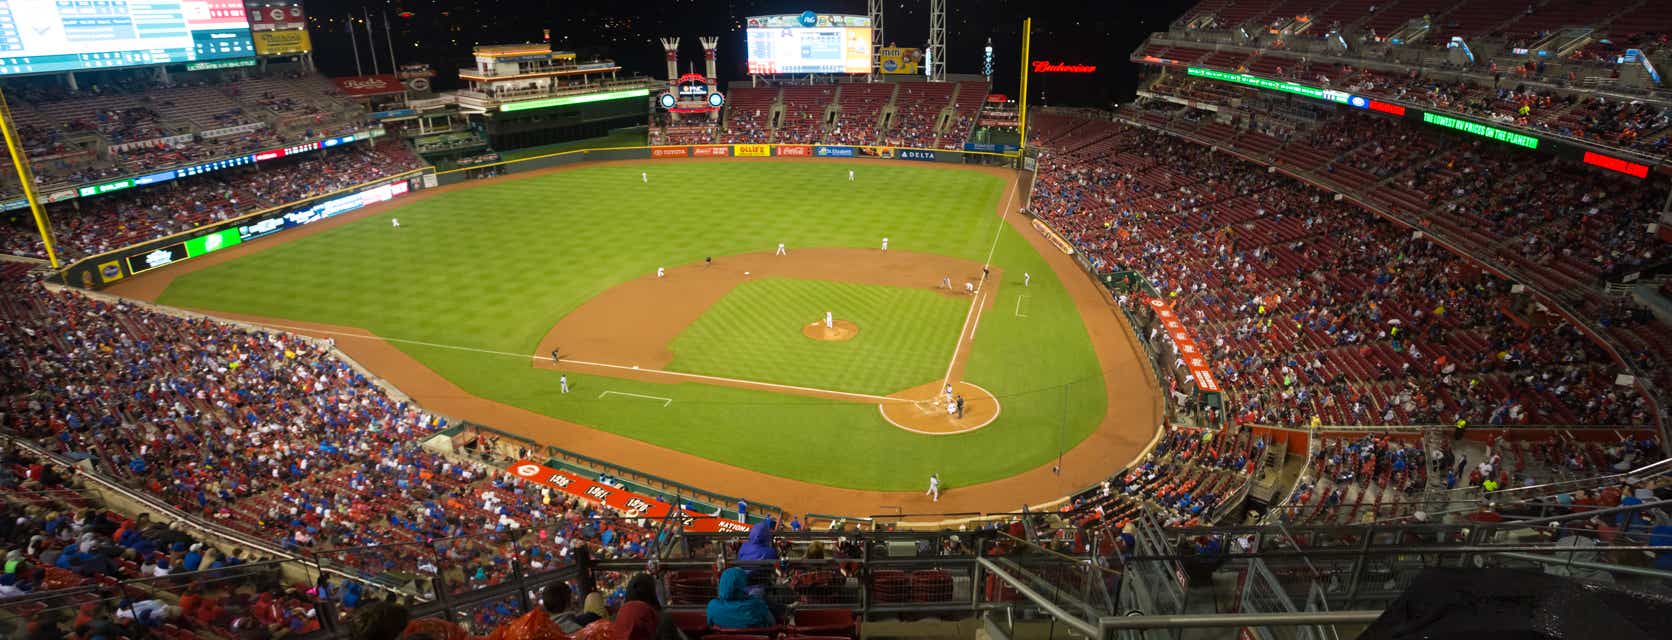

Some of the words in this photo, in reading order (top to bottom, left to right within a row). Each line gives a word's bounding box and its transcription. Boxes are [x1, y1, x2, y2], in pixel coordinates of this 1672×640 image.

[1032, 61, 1096, 73] Budweiser
[343, 78, 387, 89] Reds
[1423, 112, 1434, 122] THE
[1434, 115, 1456, 128] LOWEST
[1464, 122, 1485, 136] PRICES
[1495, 130, 1507, 141] THE
[909, 151, 935, 159] DELTA
[718, 521, 751, 533] NATIONA
